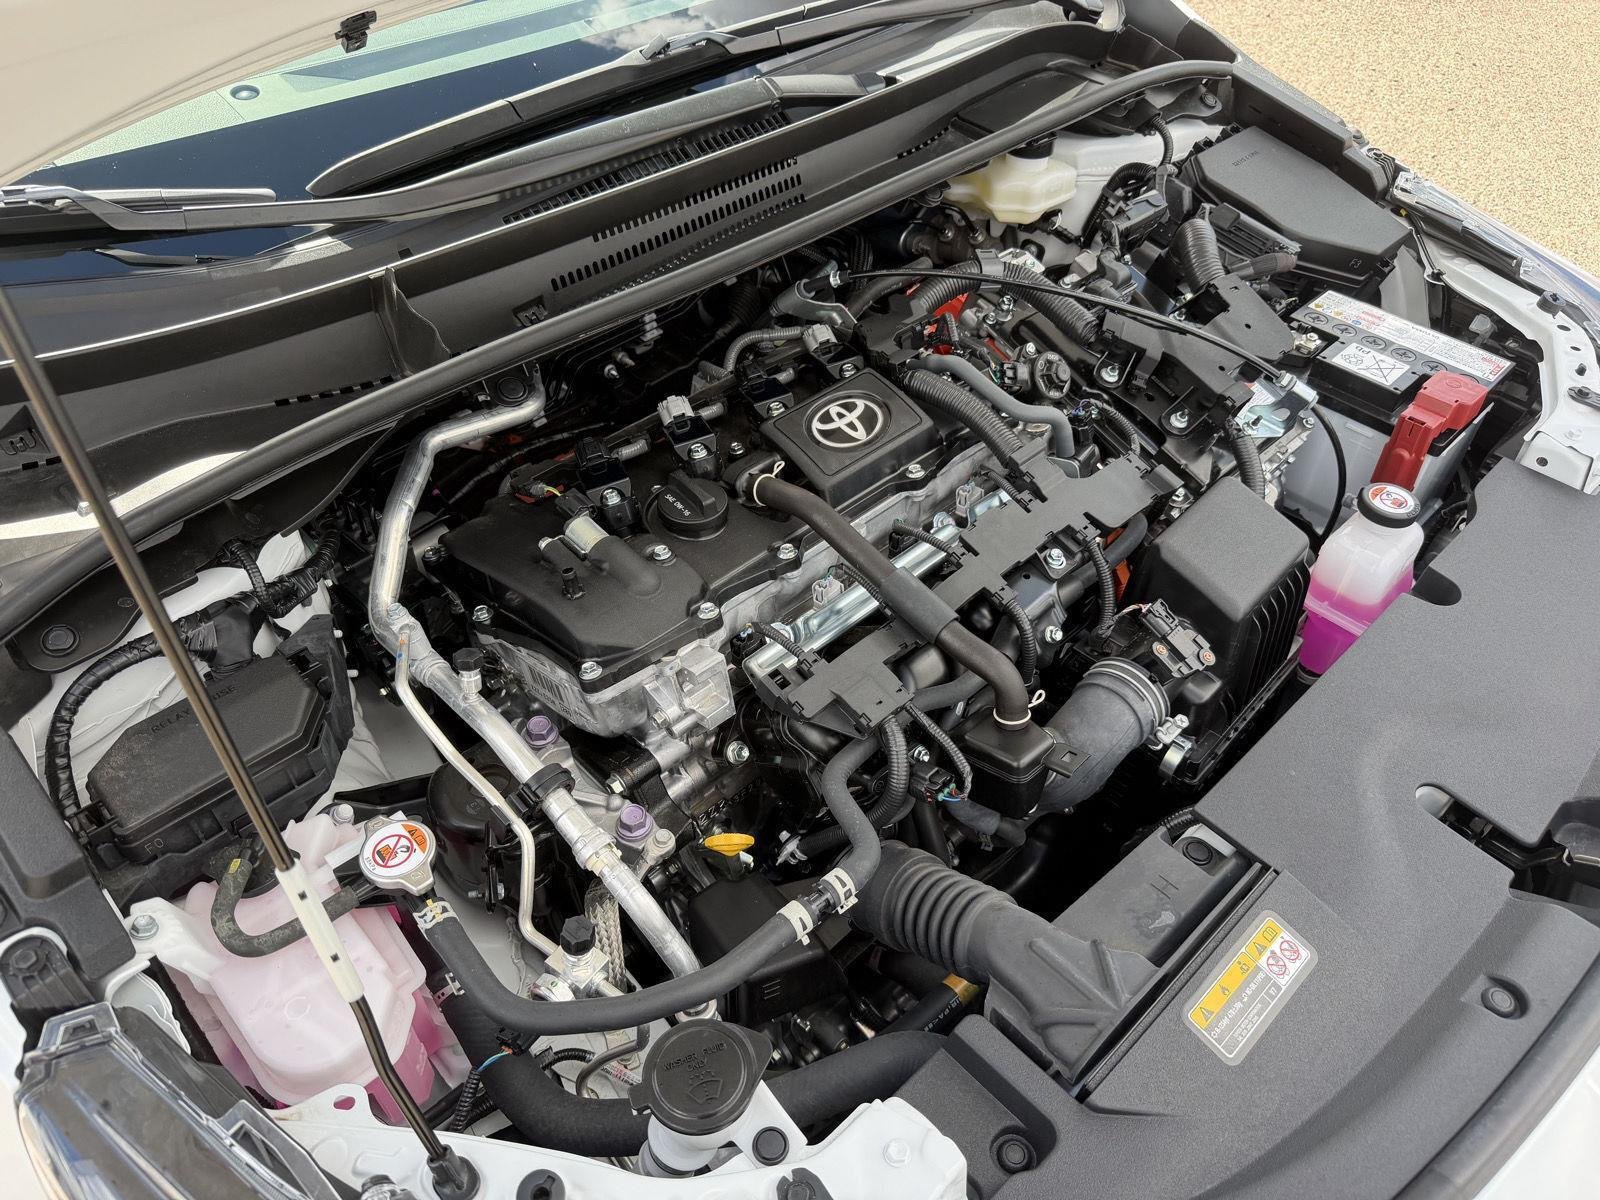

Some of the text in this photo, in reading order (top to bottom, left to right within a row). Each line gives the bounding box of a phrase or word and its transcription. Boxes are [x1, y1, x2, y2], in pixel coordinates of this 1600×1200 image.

[664, 494, 676, 503] SAE
[151, 685, 237, 733] RELAY USE
[663, 1052, 697, 1072] WASHER
[702, 1040, 726, 1055] FLUID
